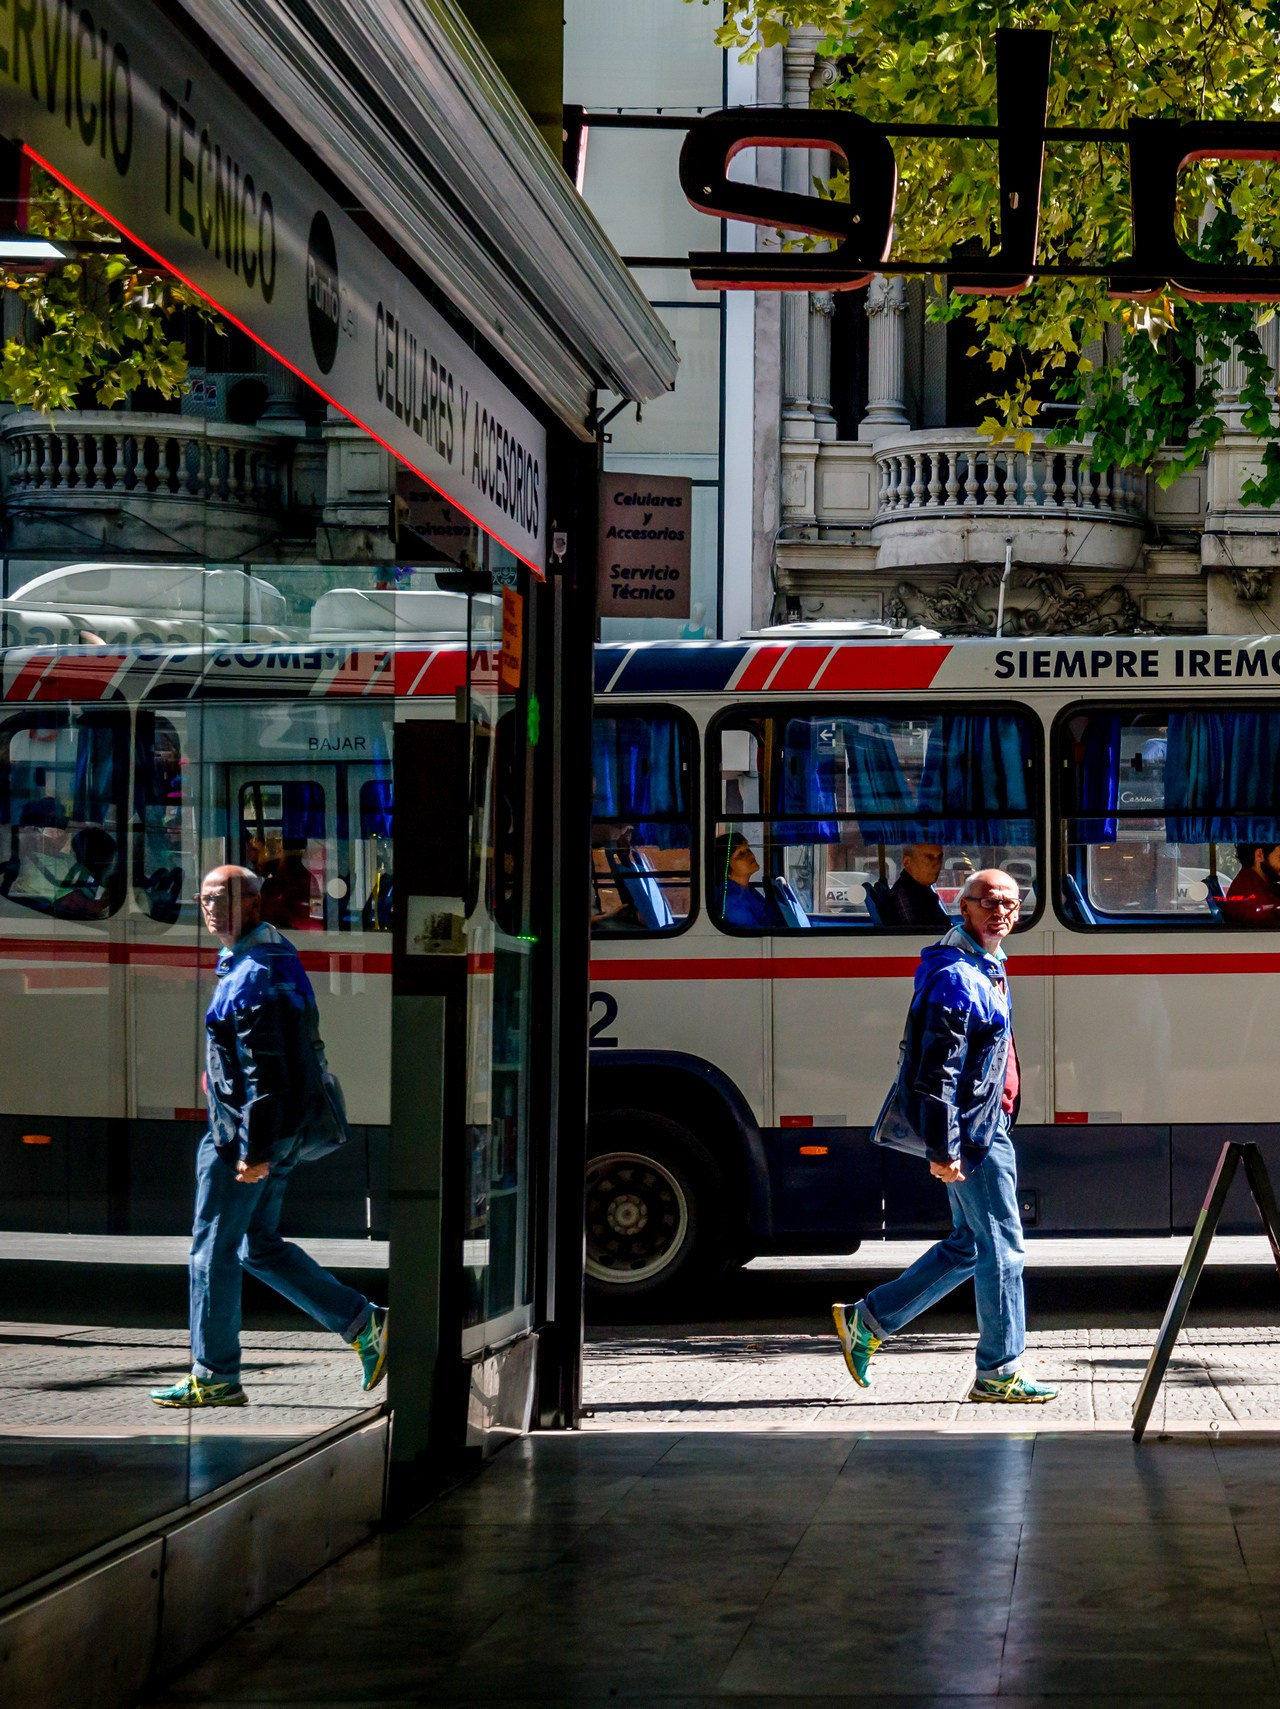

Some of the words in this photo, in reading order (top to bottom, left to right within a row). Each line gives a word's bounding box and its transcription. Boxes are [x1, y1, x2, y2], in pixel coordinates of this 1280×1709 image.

[160, 78, 275, 303] TÉCNICO
[308, 254, 338, 324] Punto
[374, 301, 454, 464] CELULARES
[457, 385, 470, 476] Y
[471, 400, 540, 539] ACCESORIOS
[614, 492, 682, 507] Celulares
[642, 513, 653, 525] y
[607, 525, 684, 541] Accesorios
[609, 564, 680, 581] Servicio
[611, 583, 675, 601] Técnico
[994, 650, 1159, 679] SIEMPRE
[308, 737, 366, 753] BAJAR
